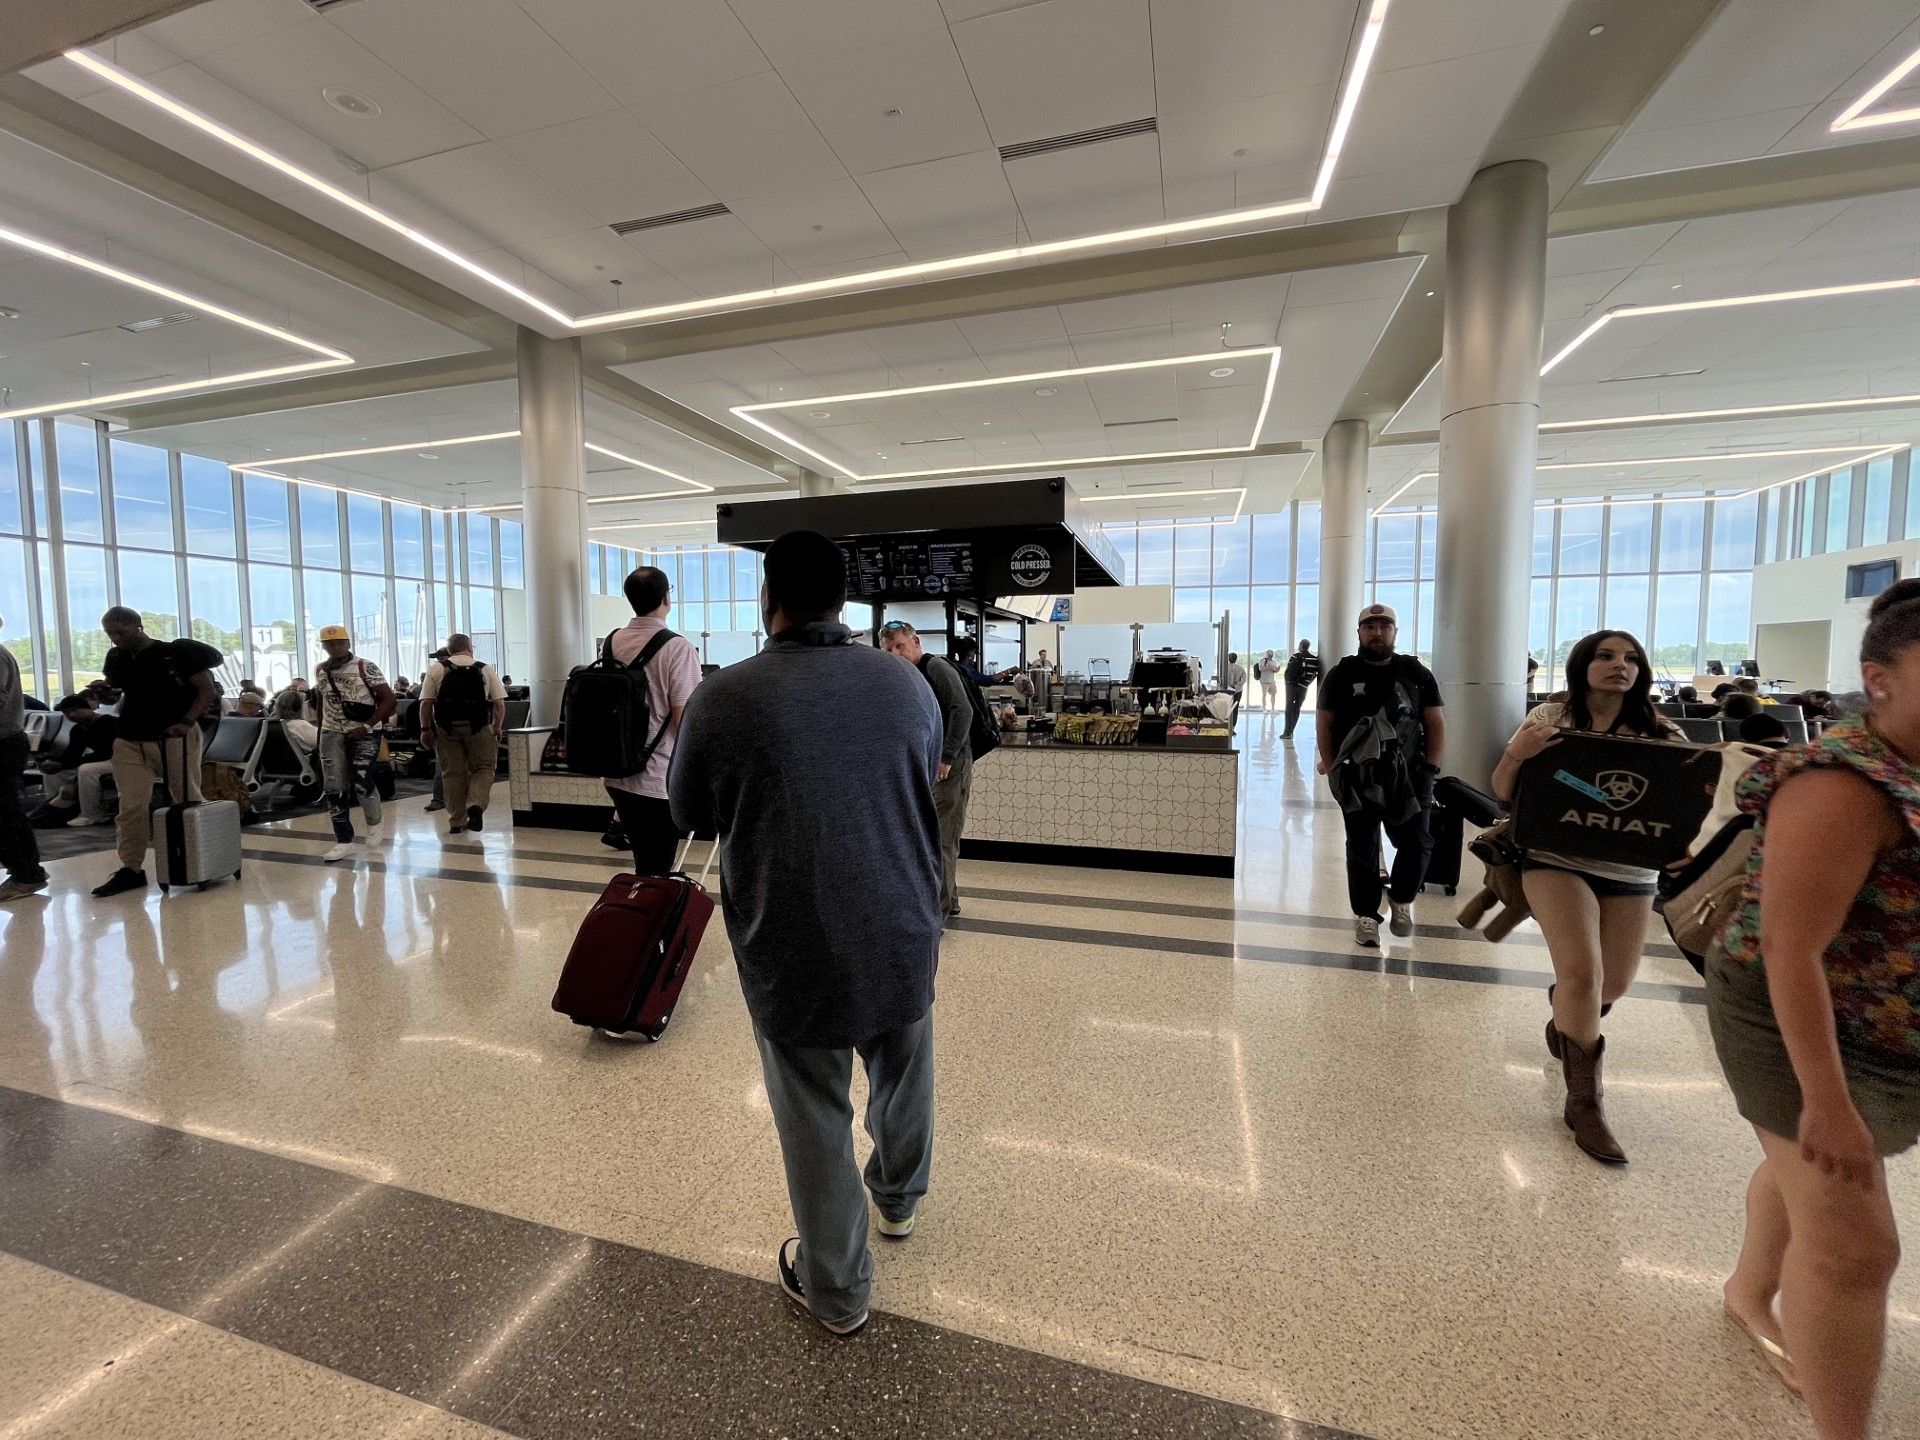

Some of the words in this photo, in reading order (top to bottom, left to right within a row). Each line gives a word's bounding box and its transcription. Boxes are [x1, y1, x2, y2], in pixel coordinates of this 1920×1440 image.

[1010, 561, 1025, 570] COLD
[1026, 560, 1050, 569] PRESSED
[258, 628, 273, 643] 11
[1559, 808, 1673, 838] ARIAT
